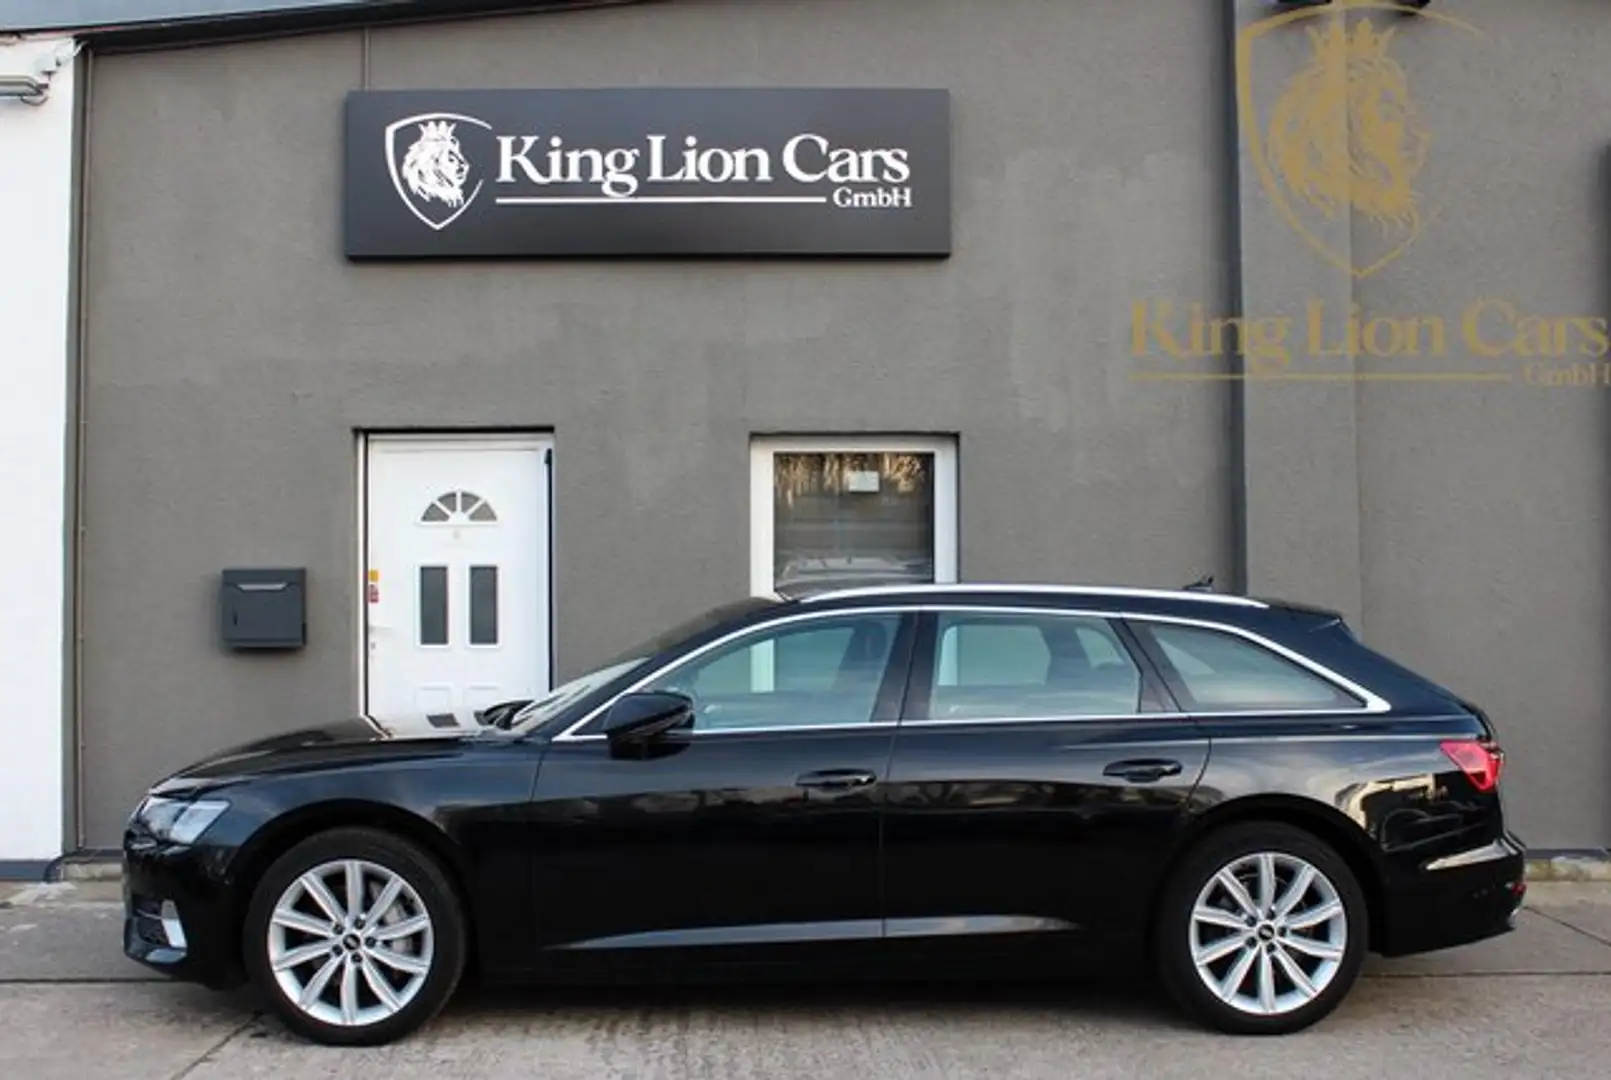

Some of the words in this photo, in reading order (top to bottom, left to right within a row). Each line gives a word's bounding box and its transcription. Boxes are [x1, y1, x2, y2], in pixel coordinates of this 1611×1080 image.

[496, 135, 640, 198] King
[646, 134, 772, 183] Lion
[782, 133, 910, 184] Cars
[832, 187, 912, 208] GmbH
